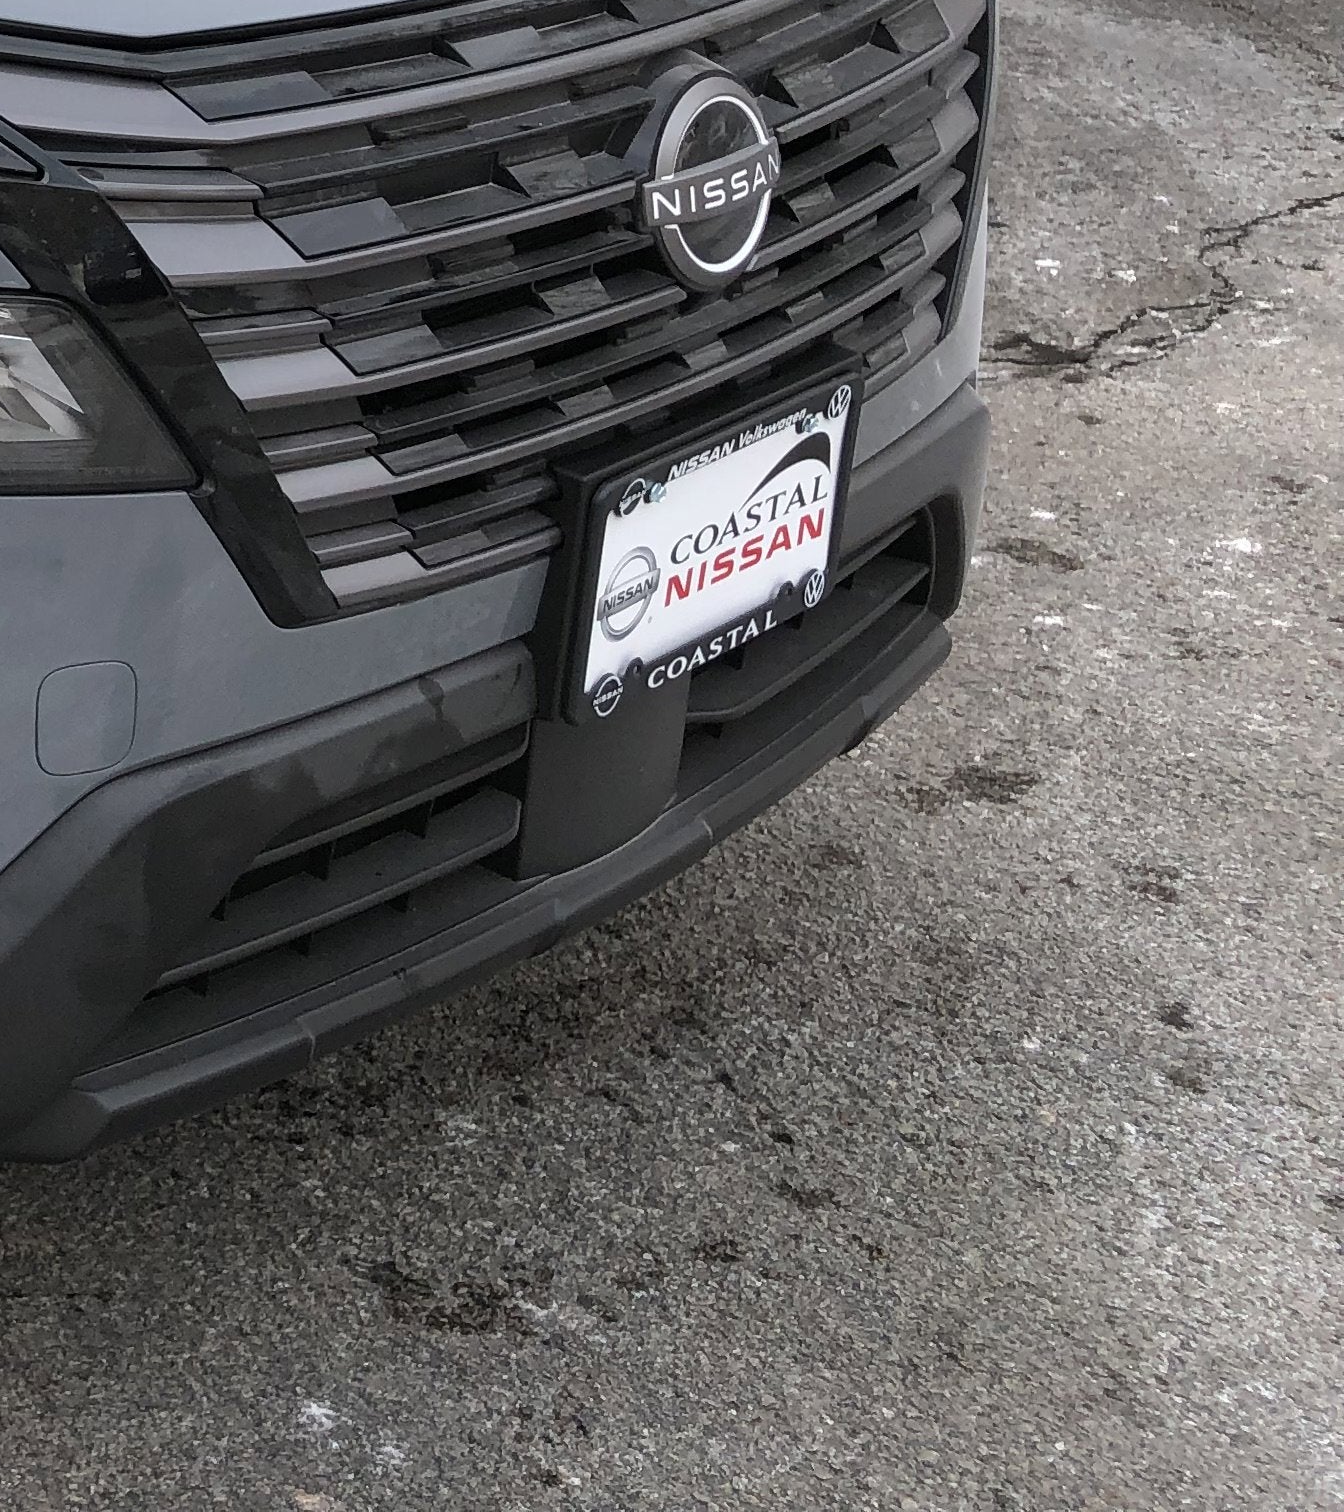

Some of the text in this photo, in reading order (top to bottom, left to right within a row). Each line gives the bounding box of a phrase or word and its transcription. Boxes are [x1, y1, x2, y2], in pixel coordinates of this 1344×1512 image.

[651, 153, 780, 220] NISSAN
[667, 407, 808, 482] NISSAN Volkswagen
[664, 507, 825, 608] NISSAN
[669, 474, 828, 565] COASTAL
[602, 576, 654, 614] NISSAN
[647, 609, 778, 689] COASTAL
